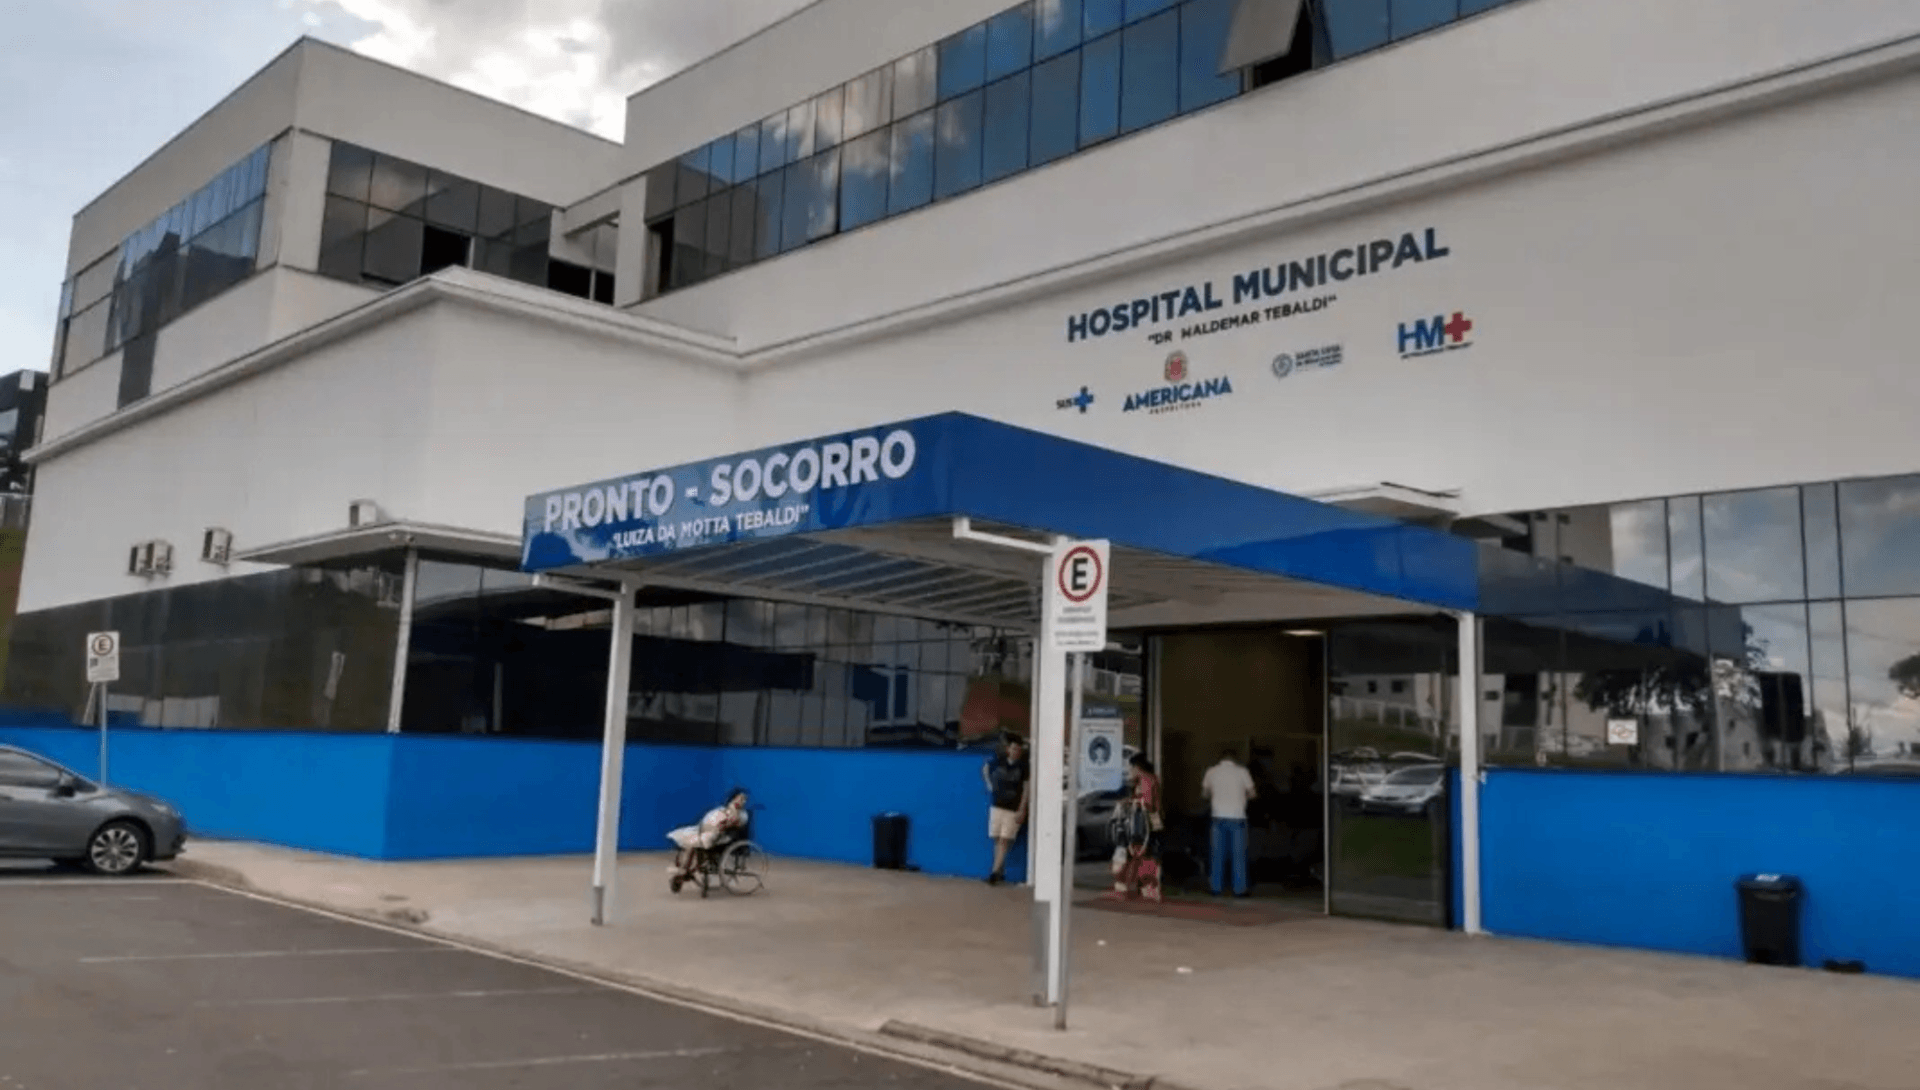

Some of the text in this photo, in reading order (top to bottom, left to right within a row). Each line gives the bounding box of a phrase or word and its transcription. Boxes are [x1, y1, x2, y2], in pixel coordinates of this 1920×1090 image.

[1068, 227, 1450, 342] HOSPITAL MUNICIPAL
[1123, 374, 1233, 413] AMERICANA
[544, 474, 675, 533] PRONTO
[709, 429, 917, 507] SOCORRO
[657, 524, 677, 542] DA
[680, 514, 731, 539] MOTTA
[1071, 557, 1089, 591] E
